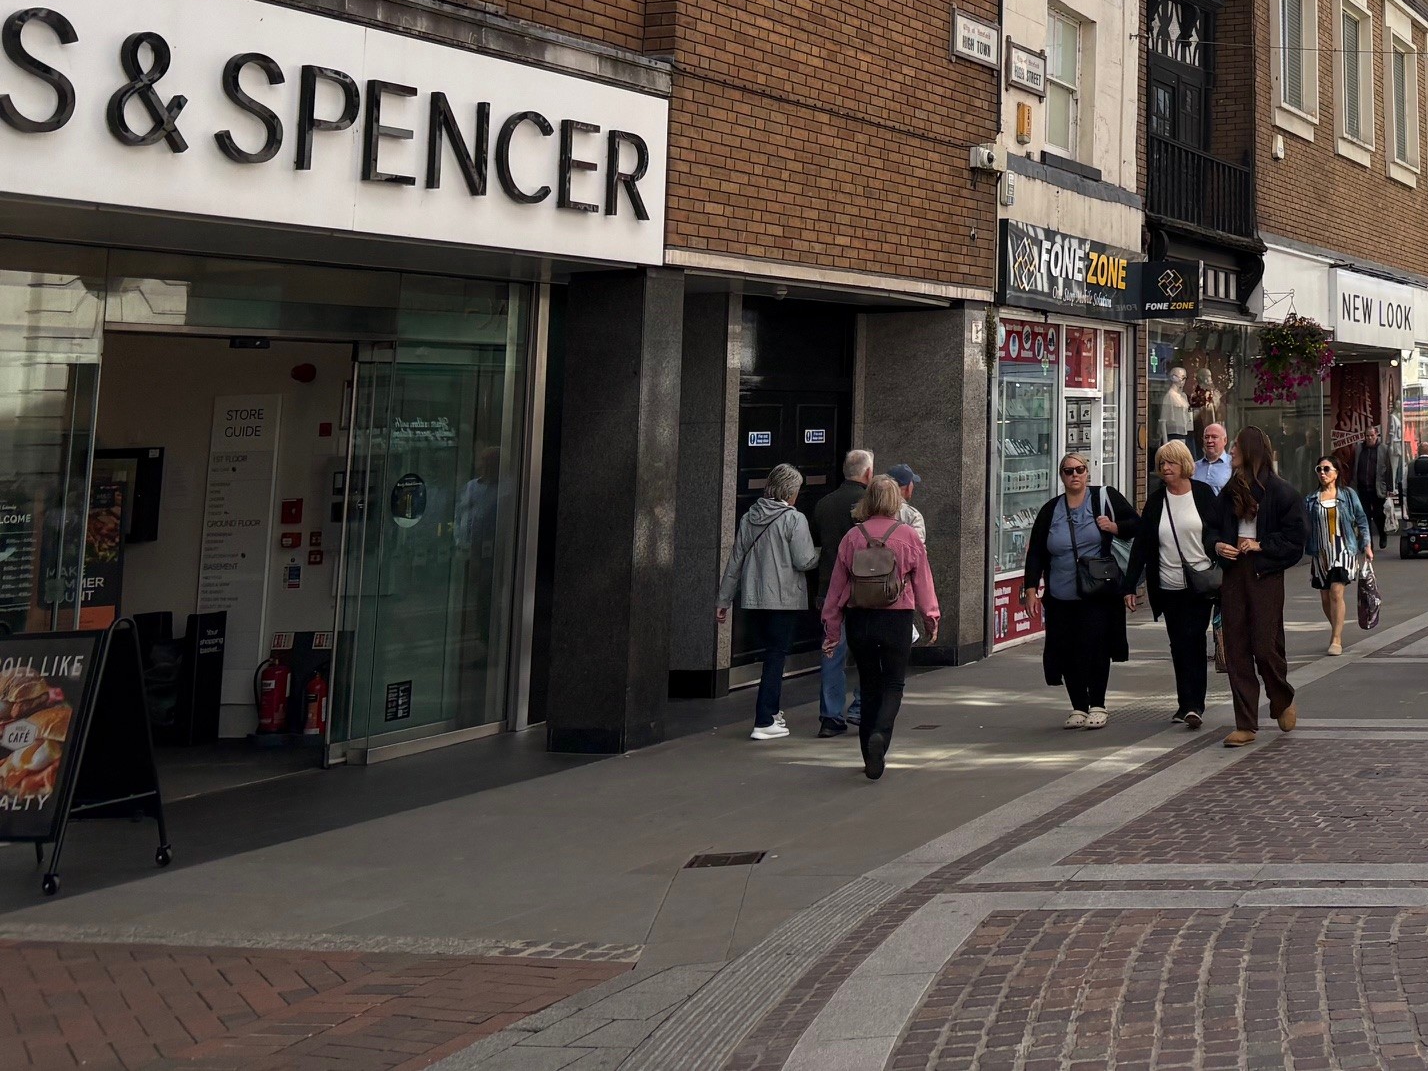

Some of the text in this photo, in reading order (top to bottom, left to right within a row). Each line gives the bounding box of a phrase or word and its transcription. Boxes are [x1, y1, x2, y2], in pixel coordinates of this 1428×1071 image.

[963, 34, 990, 57] HIGH TOWN
[1027, 69, 1041, 86] STREET
[106, 31, 189, 153] &
[214, 52, 651, 221] SPENCER
[1040, 240, 1128, 290] FONE ZONE
[1145, 301, 1195, 311] FONE ZONE
[1342, 292, 1412, 331] NEW LOOK
[226, 409, 264, 421] STORE
[224, 426, 261, 438] GUIDE
[1333, 439, 1346, 448] NOW
[1346, 434, 1360, 444] EVEN
[0, 513, 32, 524] COME
[206, 520, 236, 528] GROUND
[203, 562, 239, 570] BASEMENT
[0, 656, 34, 677] OLL
[40, 655, 84, 677] LIKE
[8, 729, 30, 743] CAFÉ
